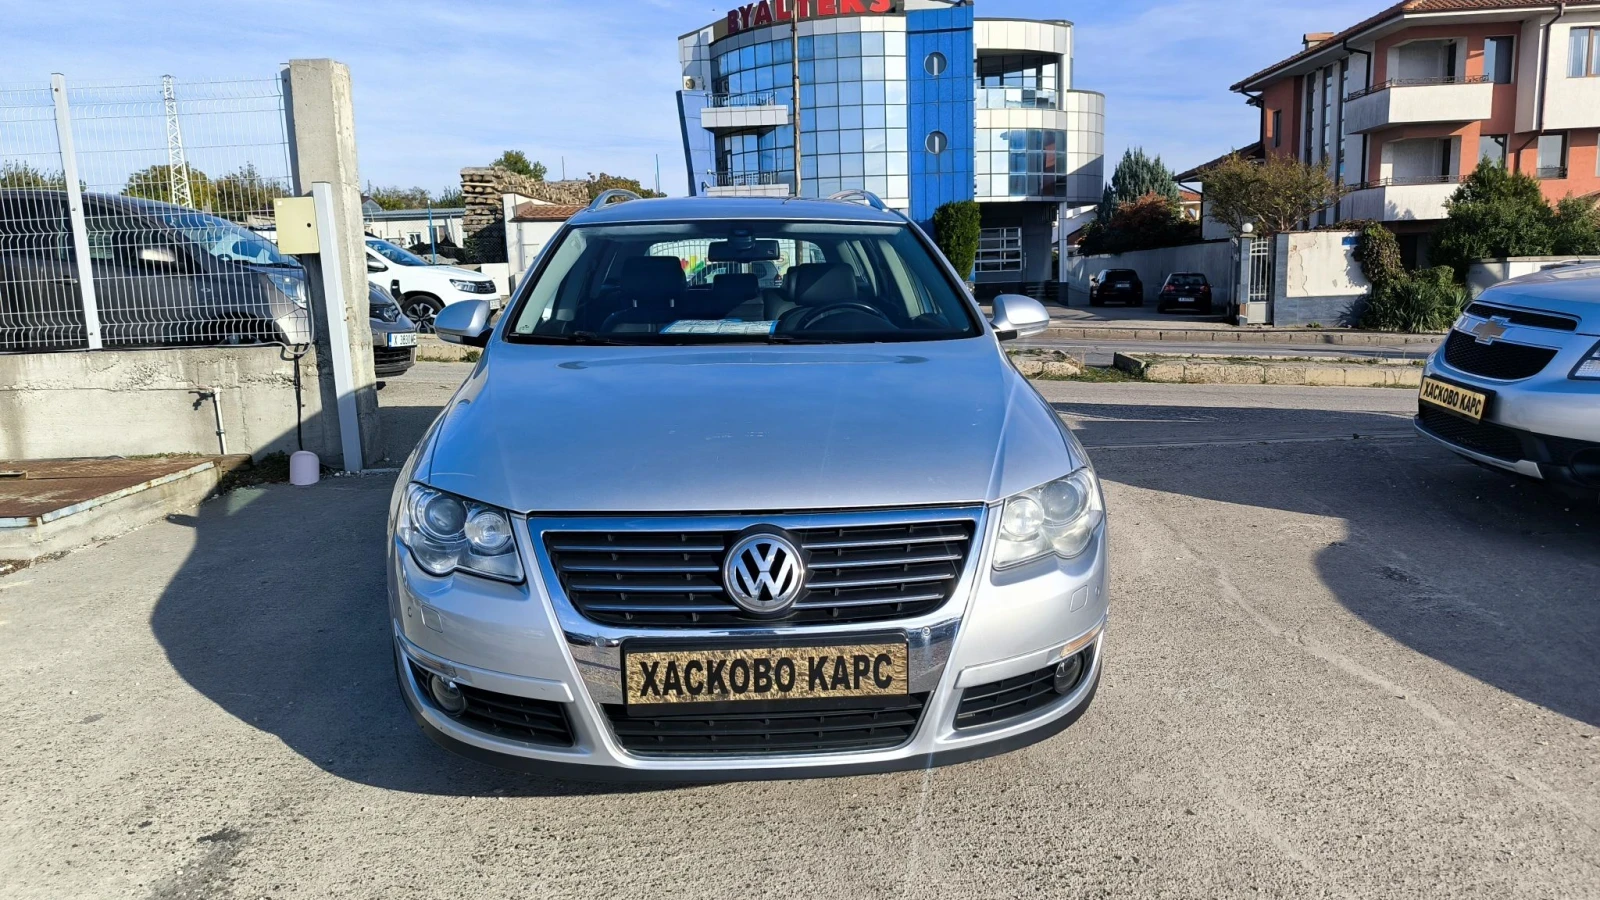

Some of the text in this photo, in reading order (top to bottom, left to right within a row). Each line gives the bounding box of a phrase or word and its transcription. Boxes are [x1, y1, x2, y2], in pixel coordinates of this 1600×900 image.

[1423, 381, 1482, 416] ХАСКОВО КАРС
[639, 653, 893, 697] ХАСКОВО КАРС
